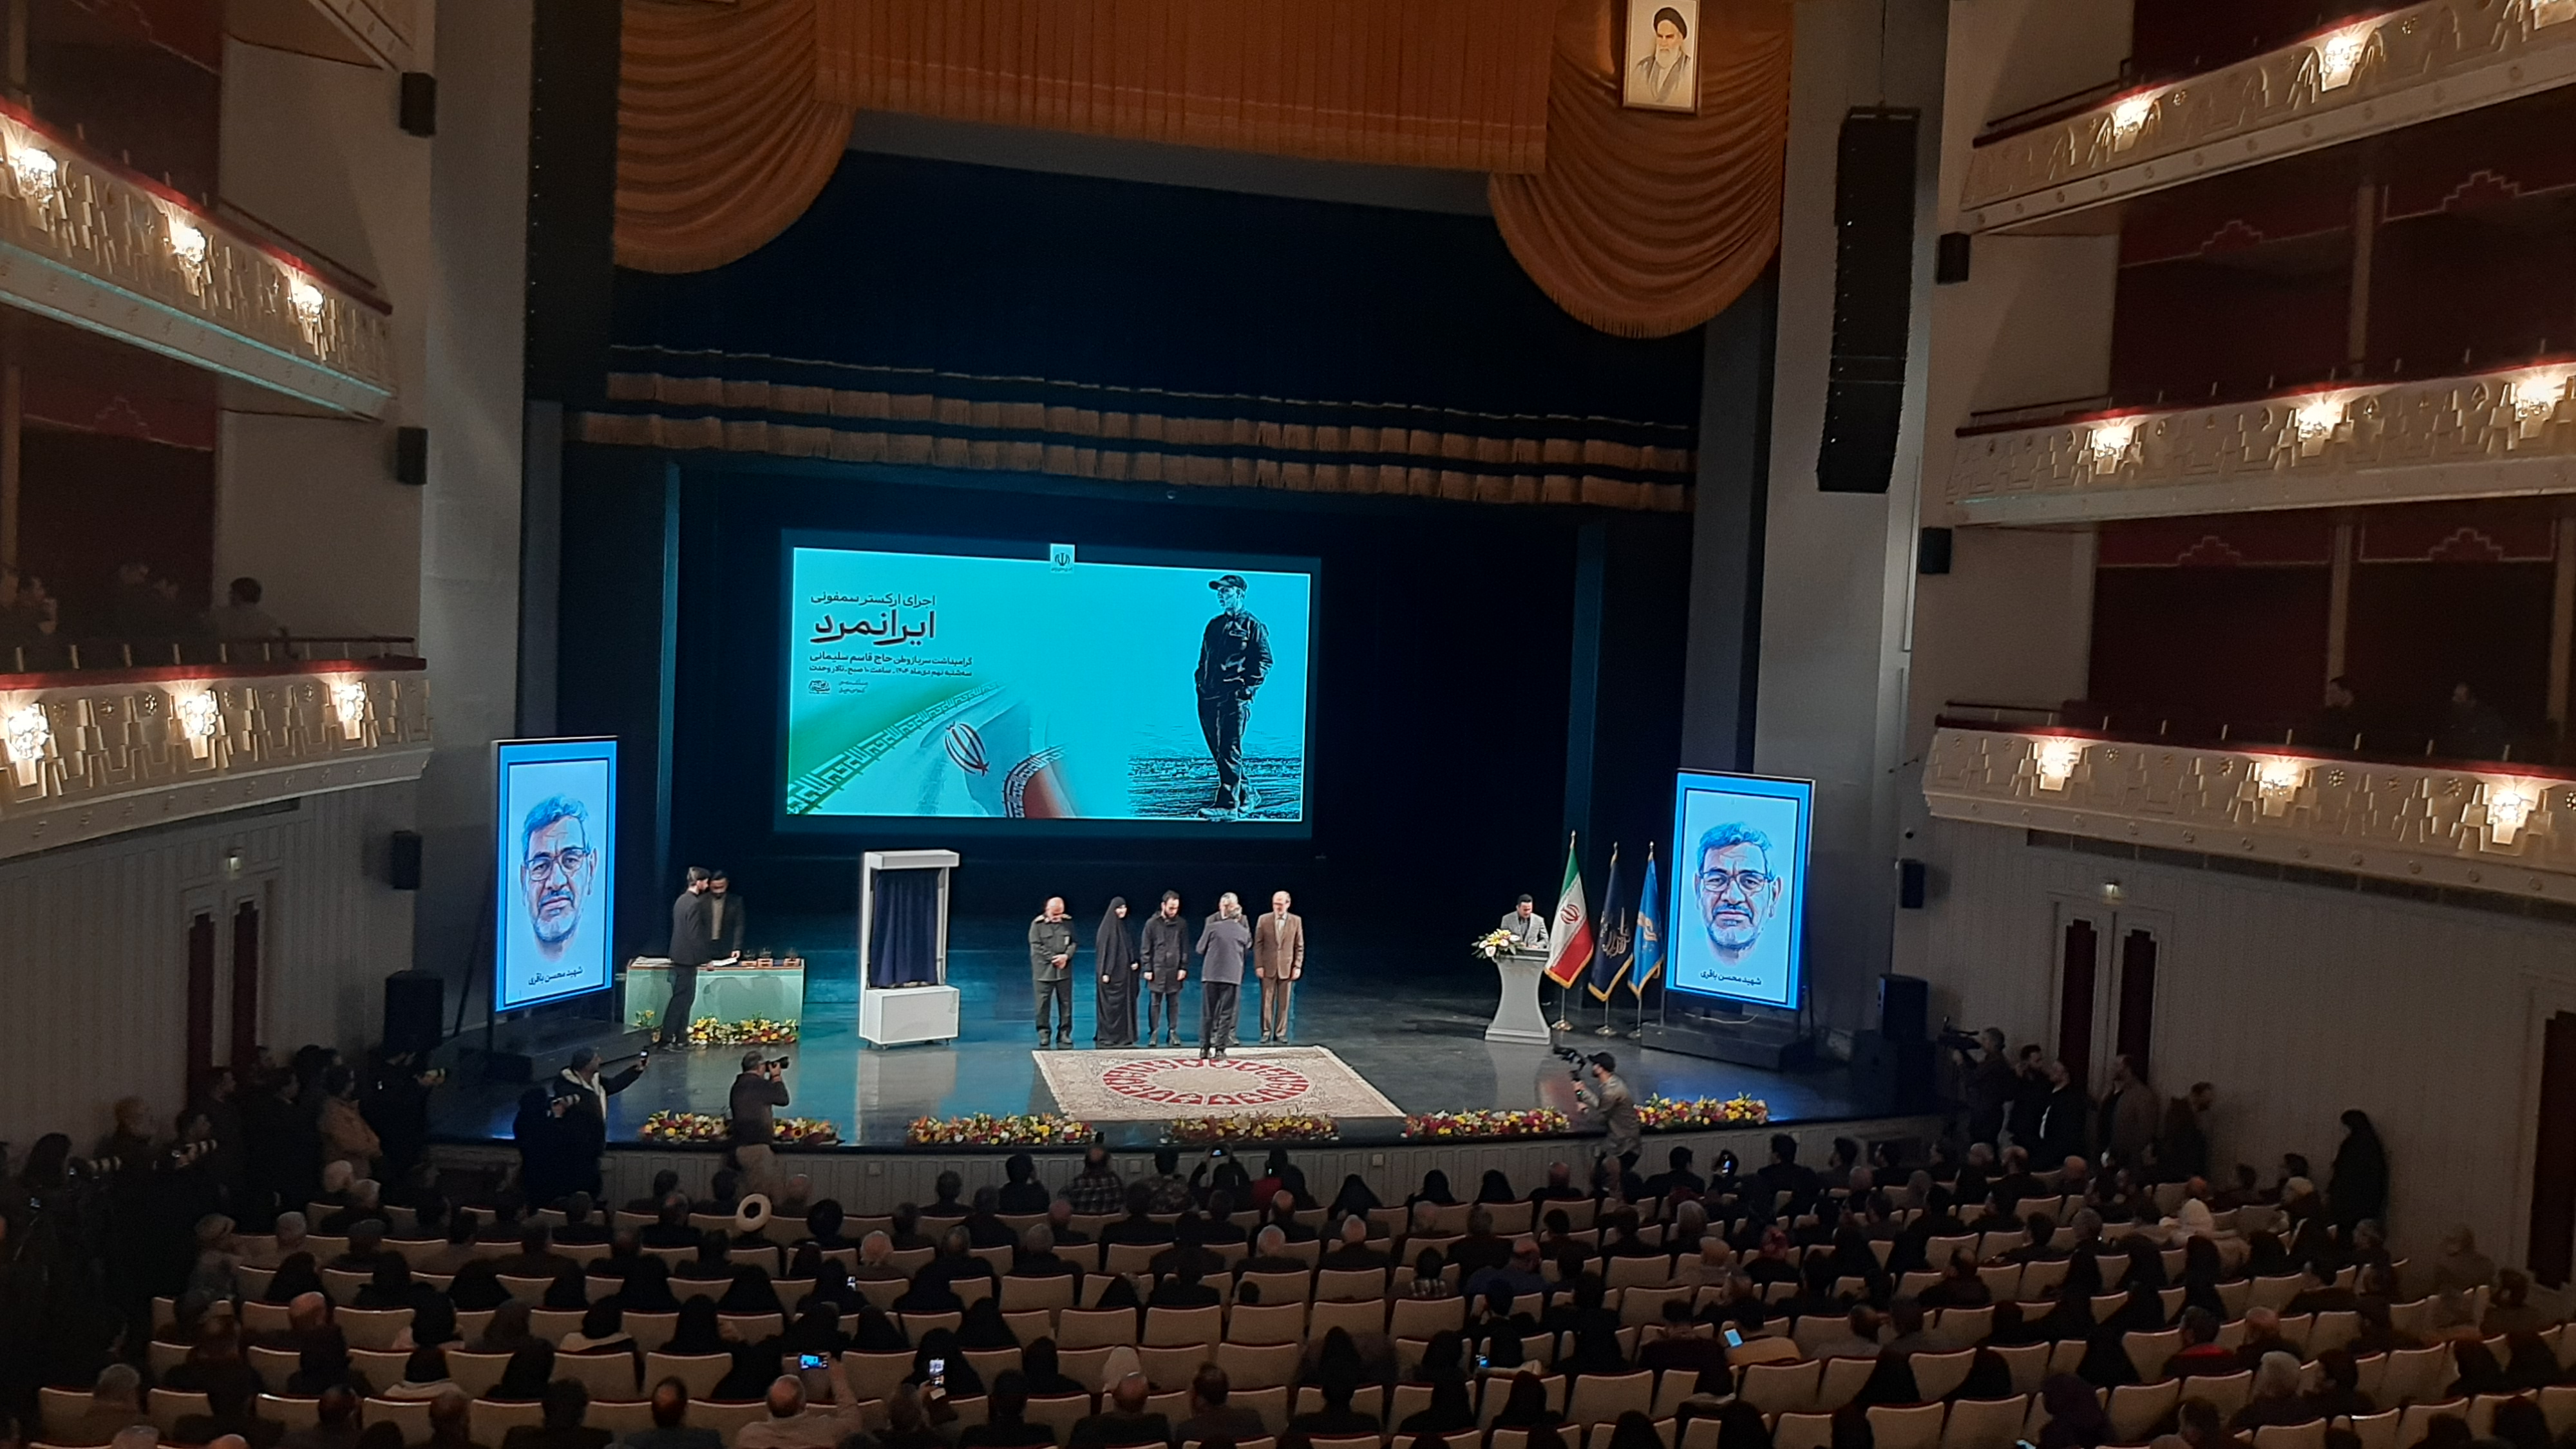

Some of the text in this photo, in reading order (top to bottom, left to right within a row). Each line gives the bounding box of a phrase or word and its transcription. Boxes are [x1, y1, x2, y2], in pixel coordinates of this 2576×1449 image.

[811, 591, 935, 609] اجرای ارکستر سمفونی
[810, 650, 849, 663] سلیمانی
[849, 652, 873, 664] قاسم
[874, 654, 893, 665] حاج
[528, 965, 583, 985] شهید محسن باقری
[1700, 969, 1762, 987] شهید محسن باقری
